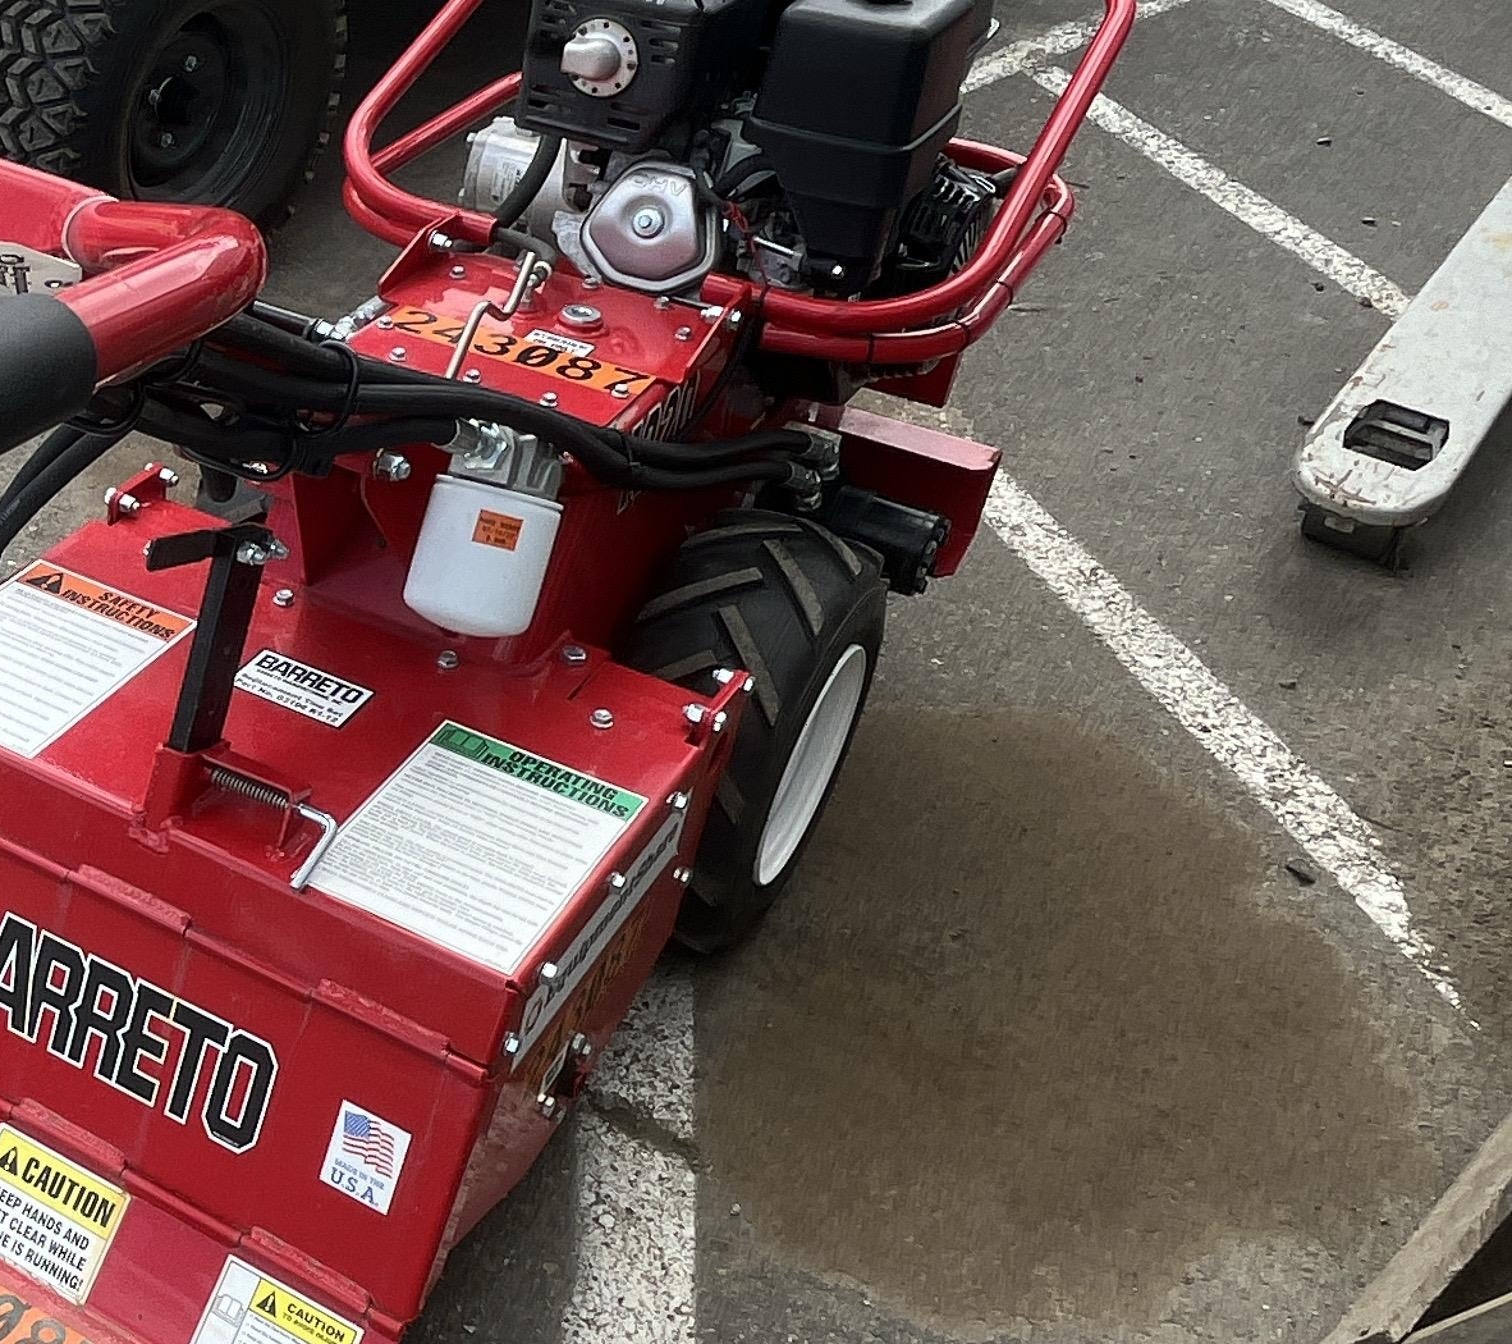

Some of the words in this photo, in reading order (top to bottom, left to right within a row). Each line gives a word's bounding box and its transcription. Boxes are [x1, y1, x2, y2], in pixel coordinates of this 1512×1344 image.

[393, 310, 650, 394] 243087
[61, 589, 175, 640] INSTRUCTIONS
[98, 591, 160, 618] SAFETY
[255, 654, 364, 704] BARRETO
[482, 751, 630, 818] INSTRUCTIONS
[509, 750, 618, 800] OPERATING
[330, 1167, 380, 1208] U.S.A.
[334, 1158, 358, 1176] MADE
[21, 1157, 116, 1228] CAUTION
[9, 1217, 46, 1248] CLEAR
[49, 1240, 87, 1272] WHILE
[21, 1202, 63, 1235] HANDS
[63, 1228, 89, 1251] AND
[11, 1239, 25, 1256] IS
[25, 1248, 84, 1292] RUNNING!
[287, 1303, 345, 1343] CAUTION
